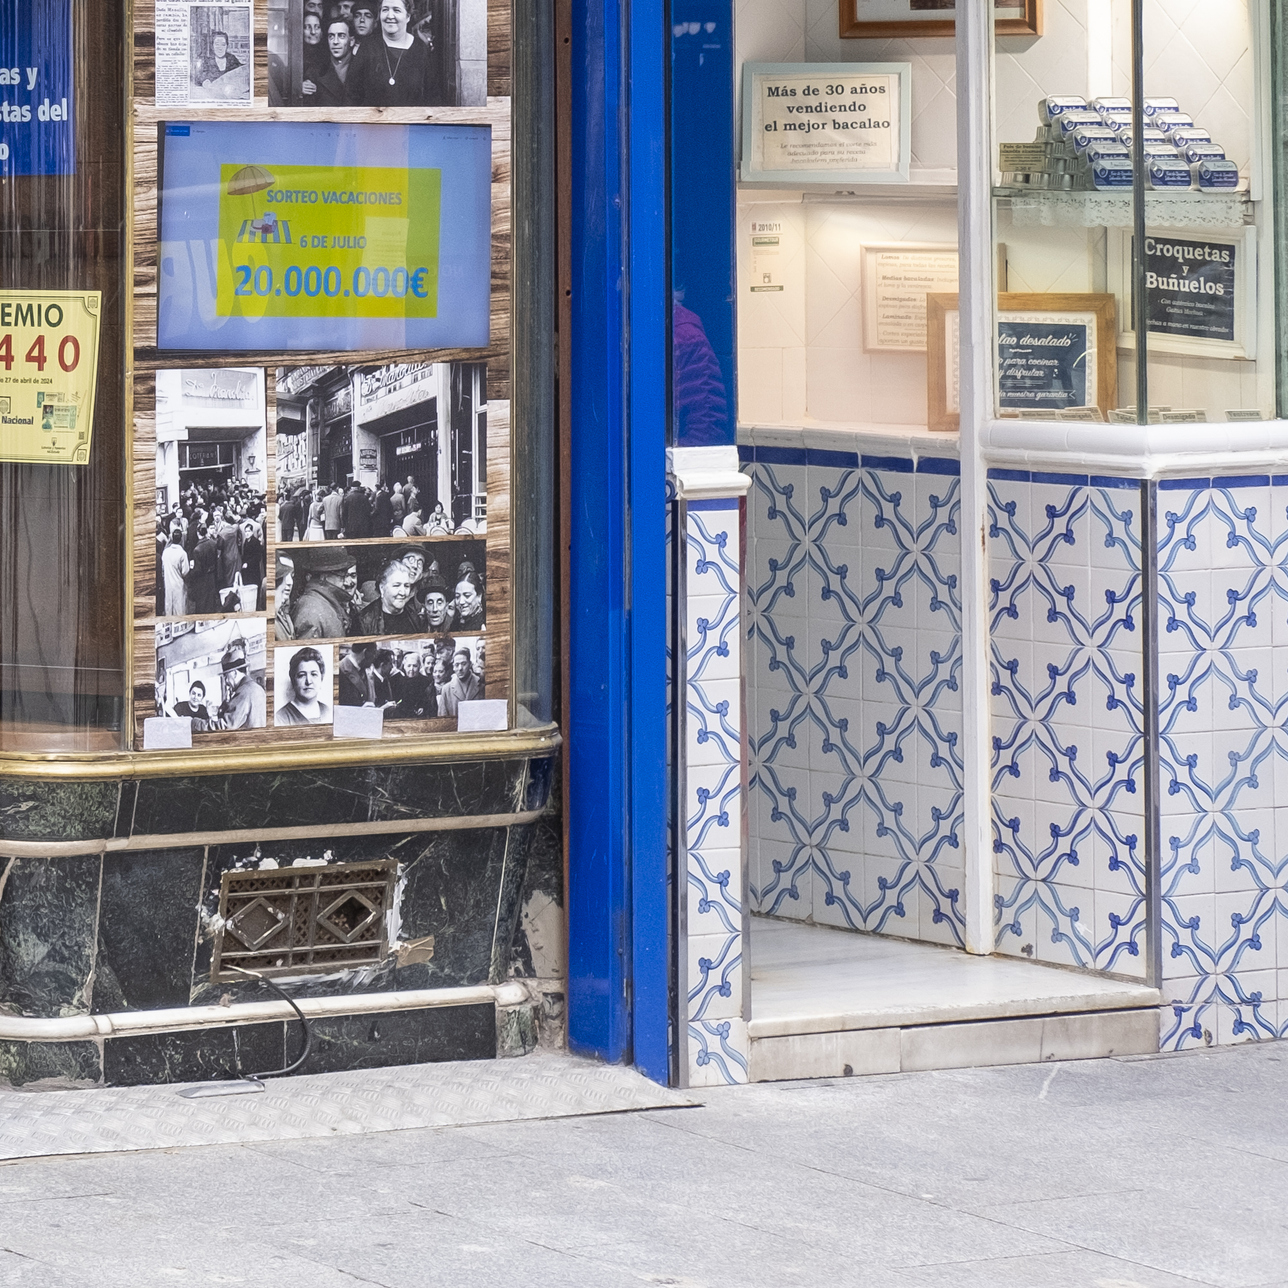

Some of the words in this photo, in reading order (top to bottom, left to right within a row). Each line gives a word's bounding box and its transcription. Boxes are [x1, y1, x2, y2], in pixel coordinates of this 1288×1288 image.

[26, 66, 38, 91] y
[767, 85, 797, 97] Más
[802, 85, 820, 96] de
[825, 84, 845, 95] 30
[850, 83, 886, 95] años
[37, 97, 68, 123] del
[786, 101, 867, 114] vendiendo
[764, 120, 778, 132] el
[783, 119, 827, 133] mejor
[832, 118, 891, 131] bacalao
[266, 189, 318, 205] SORTEO
[322, 190, 402, 206] VACACIONES
[300, 235, 308, 249] 6
[311, 236, 329, 249] DE
[331, 236, 367, 250] JULIO
[1144, 238, 1230, 263] Croquetas
[1182, 265, 1190, 276] y
[234, 265, 429, 298] 20.000.000€
[1145, 271, 1224, 296] Buñuelos
[1019, 334, 1071, 347] desalado
[20, 376, 32, 384] abril
[1, 414, 34, 425] Nacional
